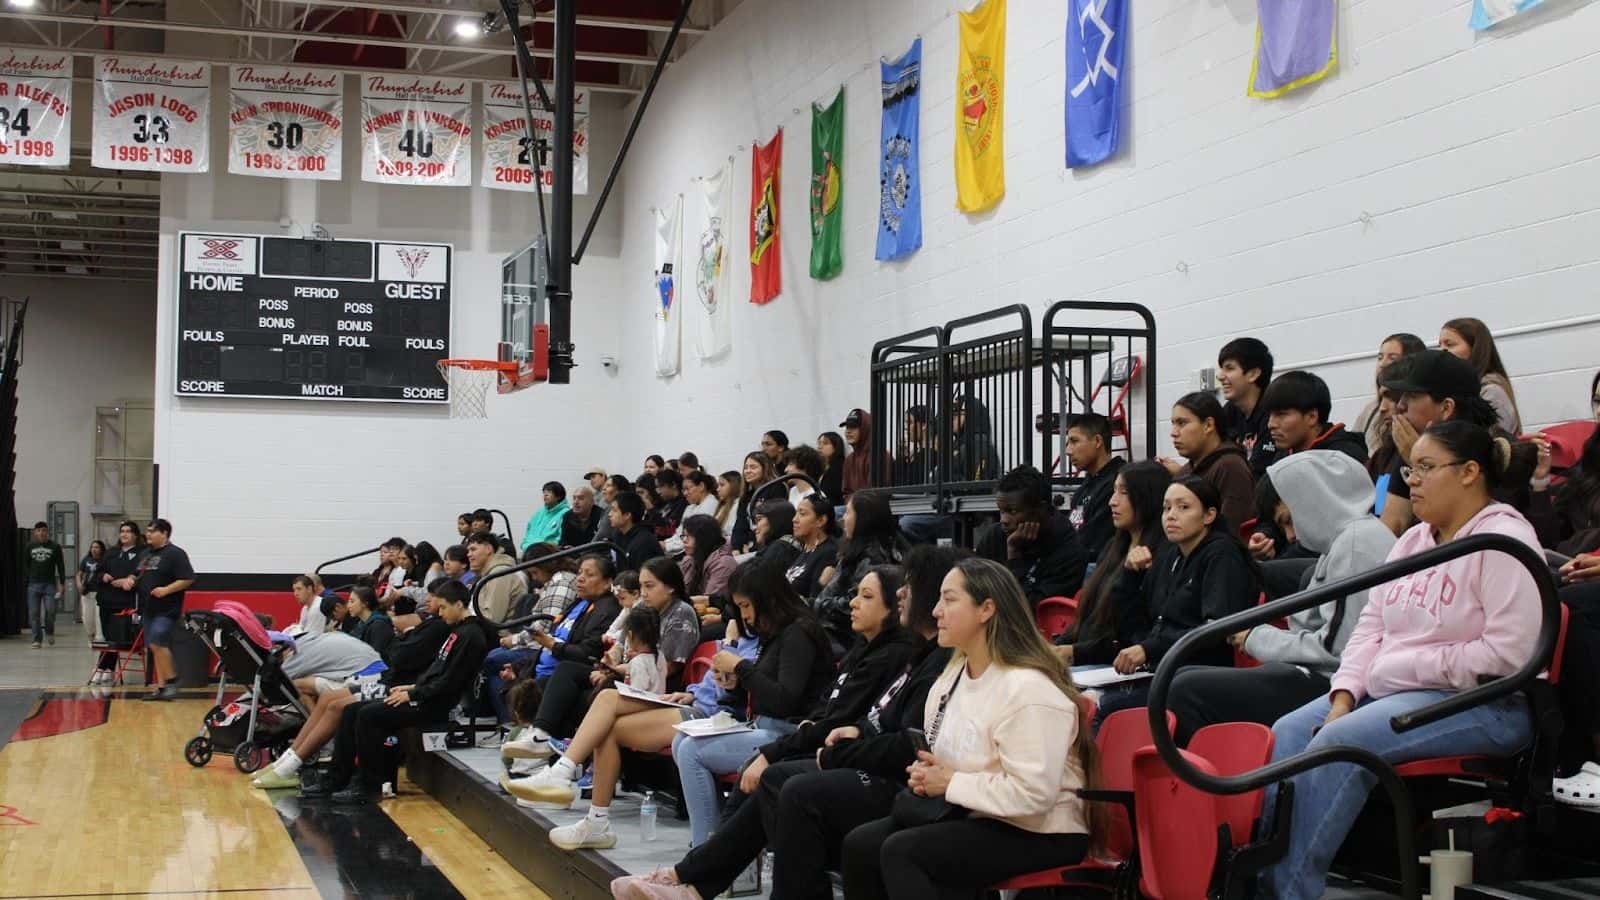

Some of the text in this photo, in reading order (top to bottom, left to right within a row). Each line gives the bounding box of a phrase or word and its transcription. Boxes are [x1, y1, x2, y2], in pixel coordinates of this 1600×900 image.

[102, 58, 204, 80] Thunderbird
[237, 67, 336, 88] Thunderbird
[368, 76, 465, 96] Thunderbird
[109, 93, 198, 123] JASON LOGG
[261, 101, 341, 130] SPOONHUNTER
[133, 115, 169, 144] 33
[366, 110, 402, 134] JENNA
[267, 122, 303, 150] 30
[399, 129, 433, 158] 40
[110, 145, 193, 164] 1996-1998
[245, 153, 326, 171] 1998-2000
[190, 274, 243, 292] HOME
[385, 283, 445, 300] GUEST
[294, 286, 339, 299] PERIOD
[259, 299, 289, 311] POSS
[344, 302, 373, 314] POSS
[259, 317, 295, 329] BONUS
[337, 320, 373, 332] BONUS
[183, 330, 224, 342] FOULS
[282, 334, 370, 347] PLAYER FOUL
[405, 338, 445, 350] FOULS
[181, 380, 225, 393] SCORE
[302, 384, 344, 396] MATCH
[403, 387, 445, 400] SCORE
